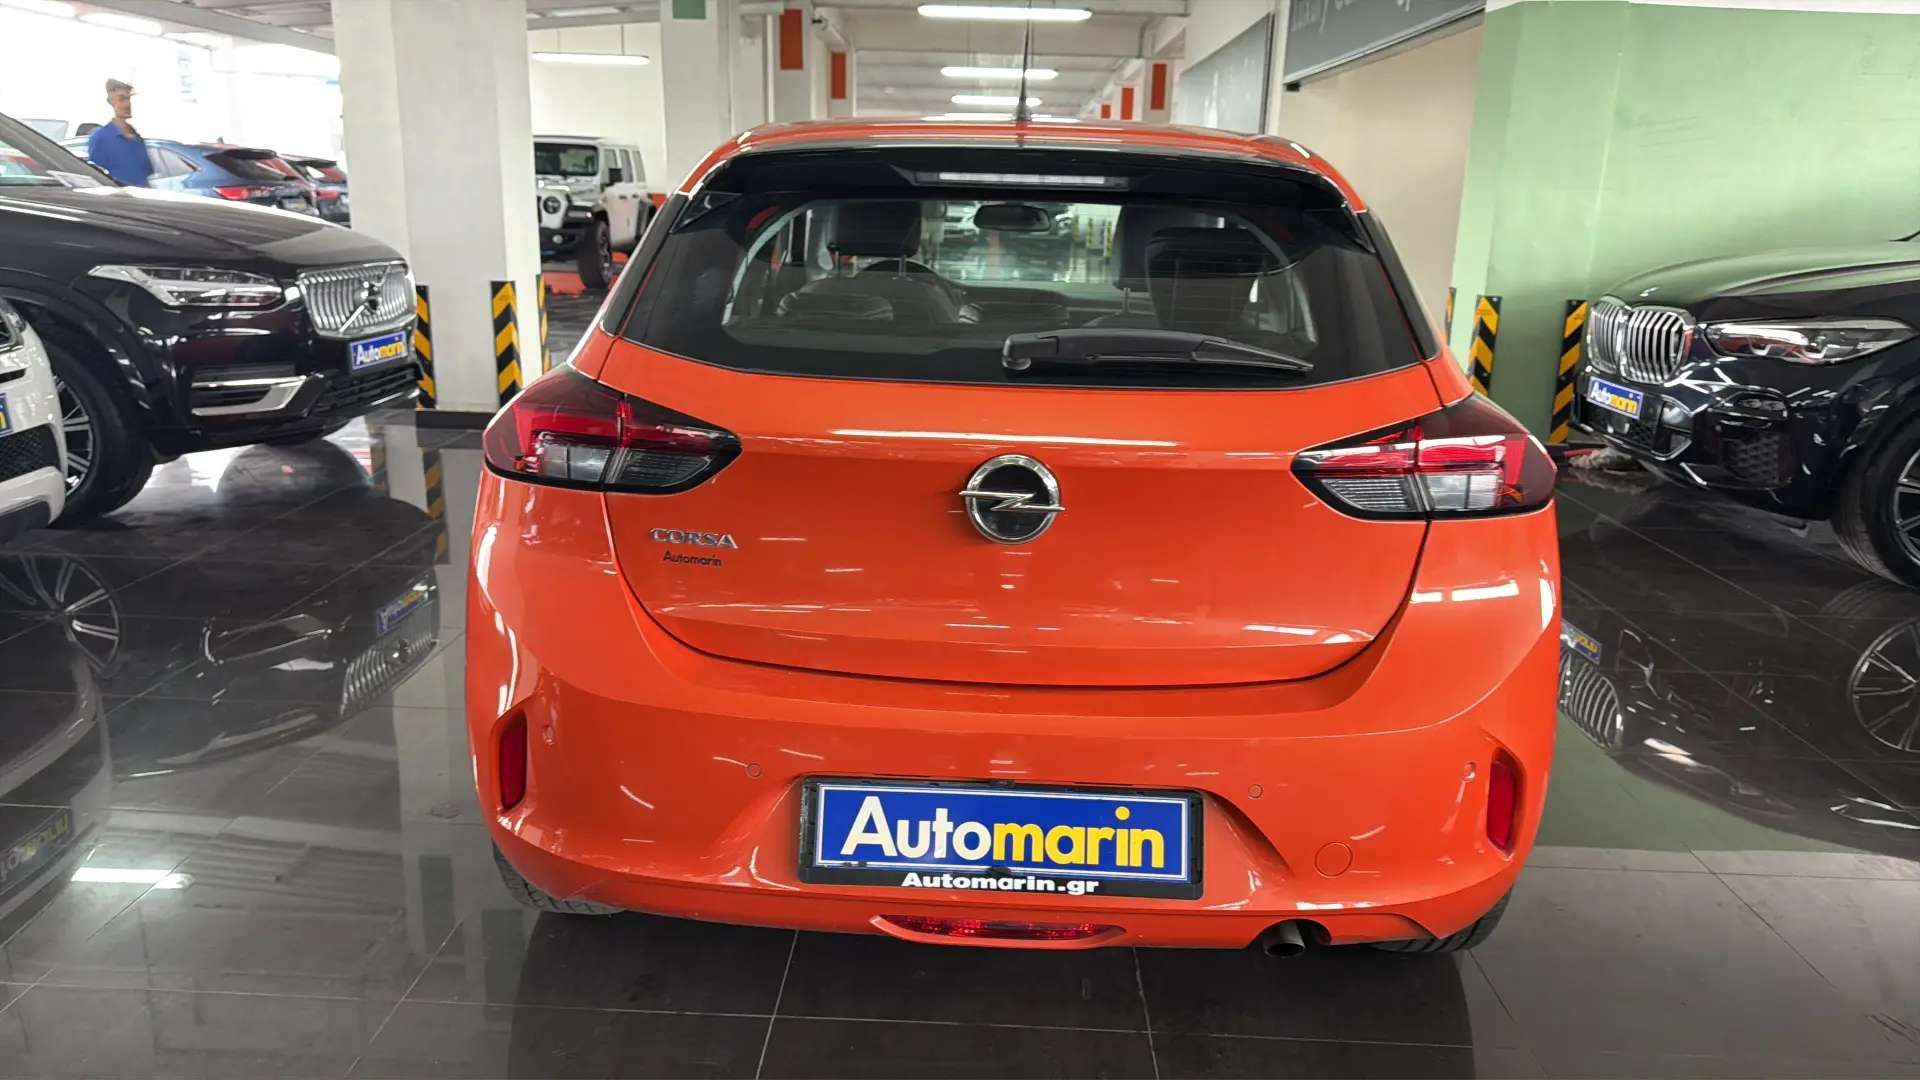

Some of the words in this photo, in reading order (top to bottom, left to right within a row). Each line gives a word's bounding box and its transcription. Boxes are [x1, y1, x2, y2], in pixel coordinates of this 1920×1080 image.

[650, 528, 738, 549] CORSA
[663, 550, 722, 567] Automarin
[840, 796, 1165, 868] Automarin
[902, 872, 1099, 896] Automarin.gr
